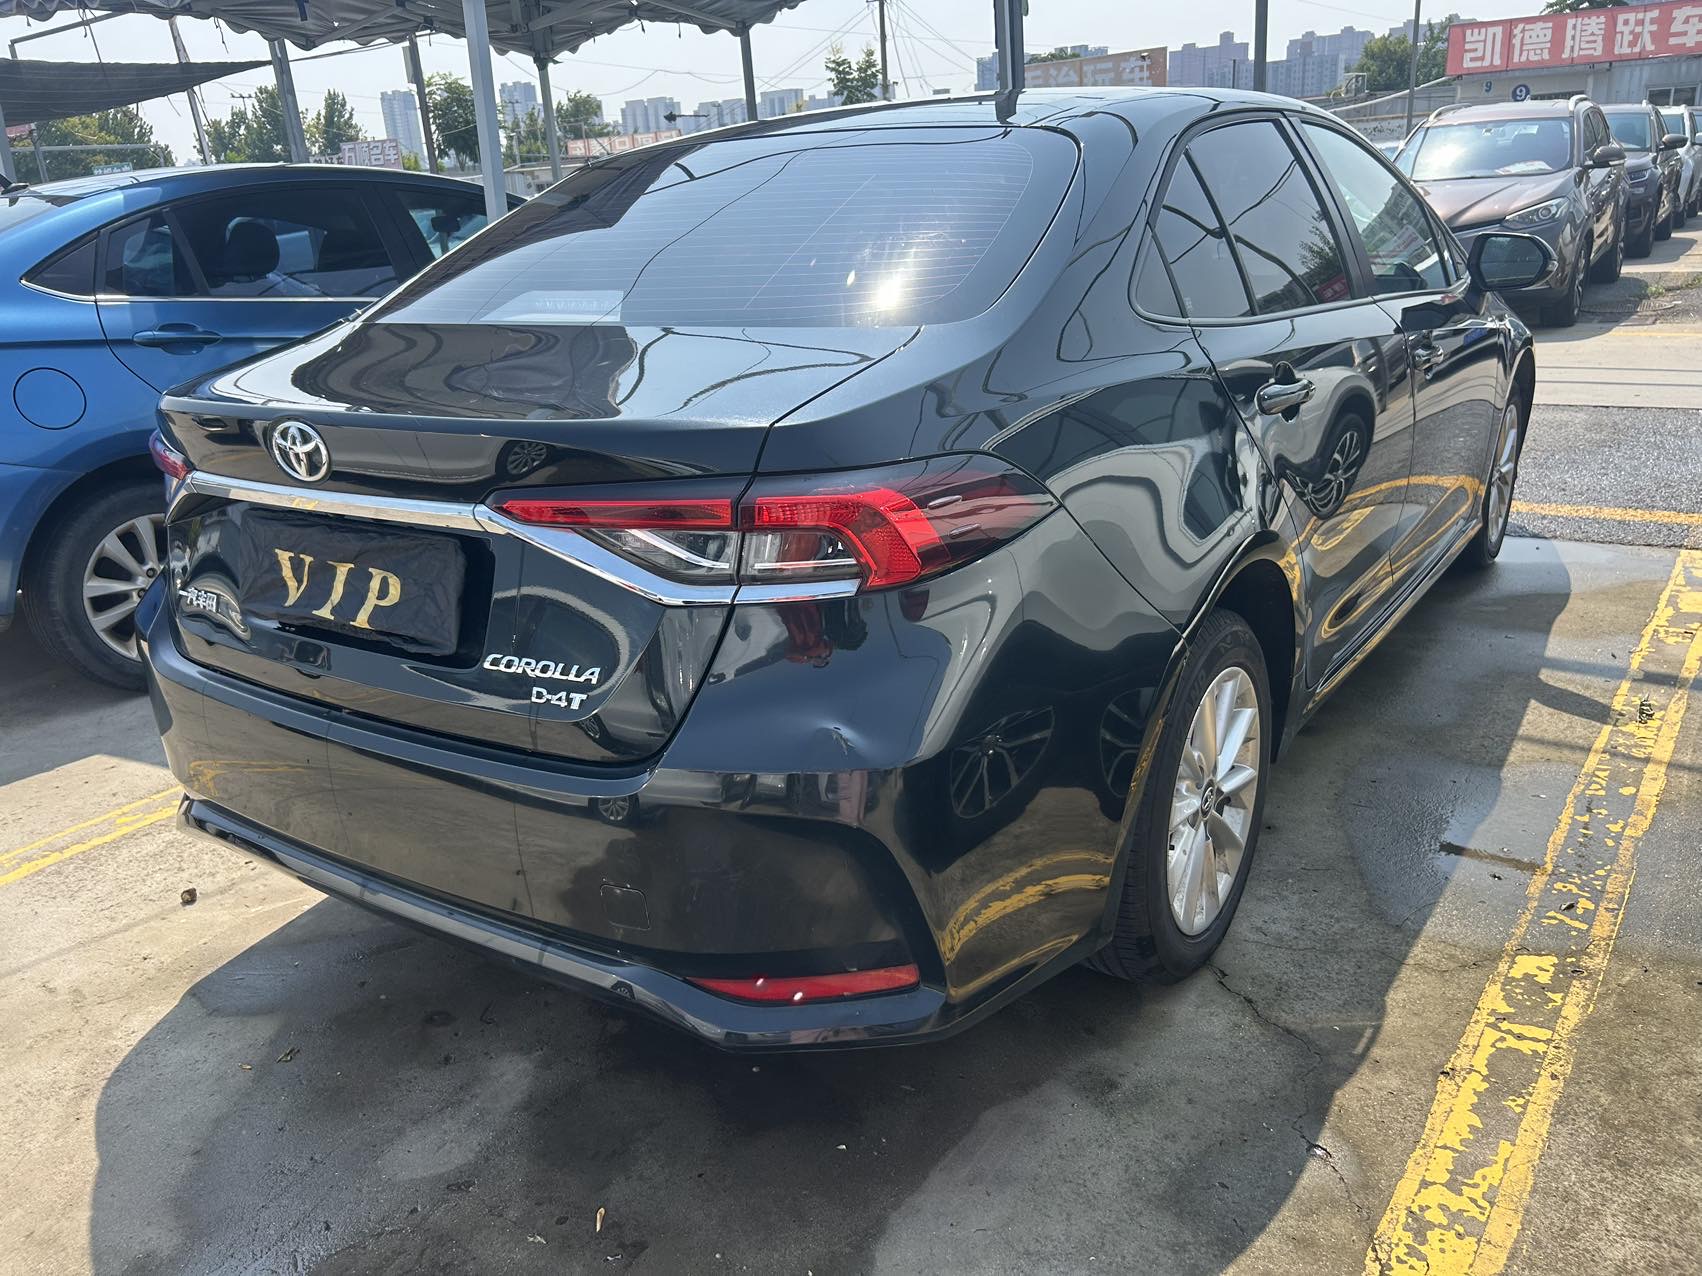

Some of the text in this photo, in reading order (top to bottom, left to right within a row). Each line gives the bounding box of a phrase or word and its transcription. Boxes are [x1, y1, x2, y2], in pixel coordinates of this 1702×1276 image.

[1484, 80, 1493, 92] 9
[1516, 86, 1527, 100] 9
[275, 548, 401, 630] VIP
[483, 654, 601, 685] COROLLA
[531, 686, 588, 710] D-4T
